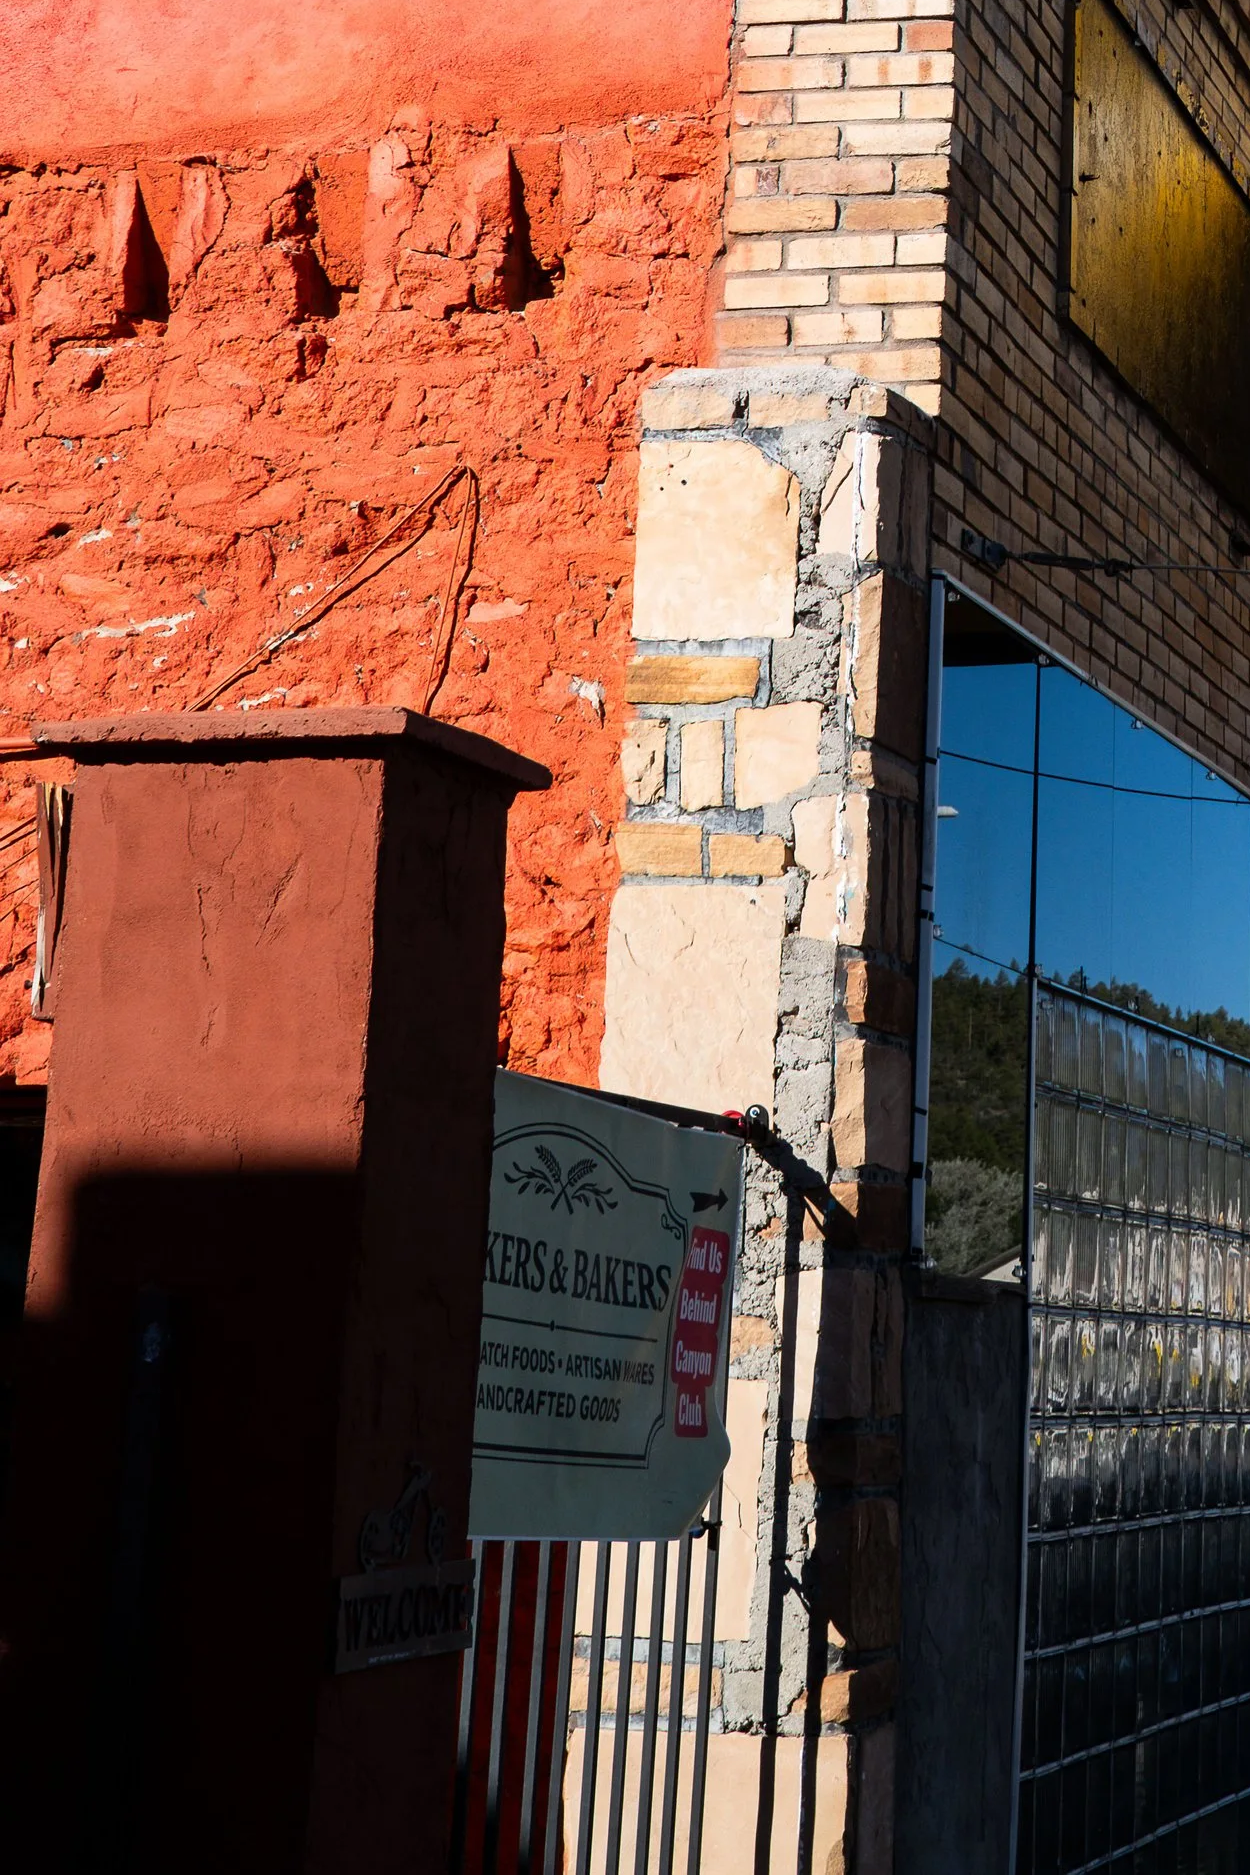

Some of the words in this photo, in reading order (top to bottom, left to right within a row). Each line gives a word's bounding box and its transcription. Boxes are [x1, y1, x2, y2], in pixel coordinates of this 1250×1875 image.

[484, 1231, 547, 1294] KERS
[550, 1248, 569, 1295] &
[571, 1248, 672, 1312] BAKERS
[708, 1243, 723, 1274] Us
[680, 1288, 717, 1324] Behind
[480, 1340, 508, 1368] ATCH
[511, 1346, 555, 1374] FOODS
[565, 1353, 622, 1381] ARTISAN
[622, 1360, 655, 1385] WARES
[675, 1340, 712, 1379] Canyon
[477, 1383, 576, 1418] ANDCRAFTED
[579, 1394, 622, 1423] GOODS
[678, 1392, 702, 1426] Club
[344, 1583, 470, 1652] WELCOME
